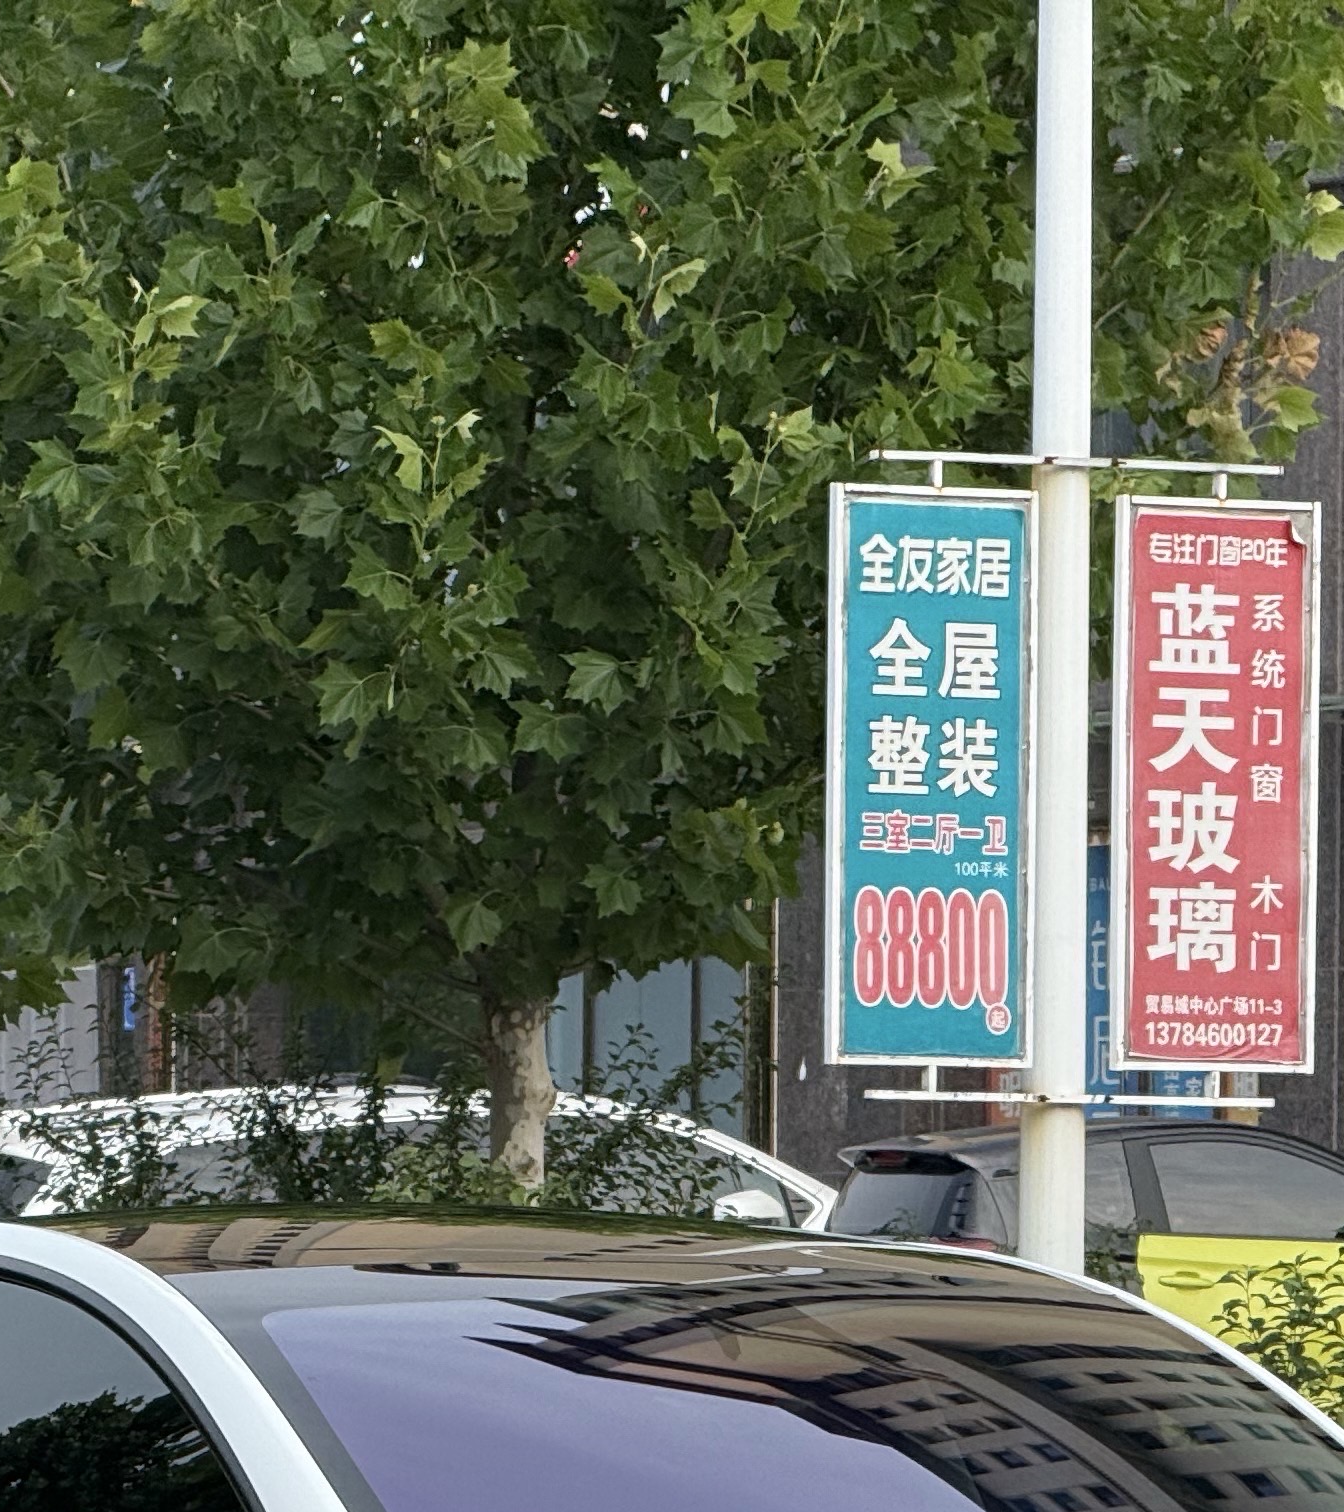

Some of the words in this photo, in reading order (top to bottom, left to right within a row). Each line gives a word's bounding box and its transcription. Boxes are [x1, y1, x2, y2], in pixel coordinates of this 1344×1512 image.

[859, 533, 1011, 598] 全友家居
[1149, 532, 1289, 568] 专注门窗20年
[869, 617, 1002, 699] 全屋
[1250, 594, 1287, 803] 系统门窗
[867, 715, 1000, 799] 整装
[1147, 583, 1242, 974] 蓝天玻璃
[859, 809, 1009, 856] 三室二厅一卫
[954, 861, 1009, 878] 100平米
[854, 885, 1009, 1010] 88800
[1250, 874, 1285, 973] 木门
[1145, 994, 1284, 1015] 贸易城中心广场11-3
[1145, 1021, 1284, 1047] 13784600127
